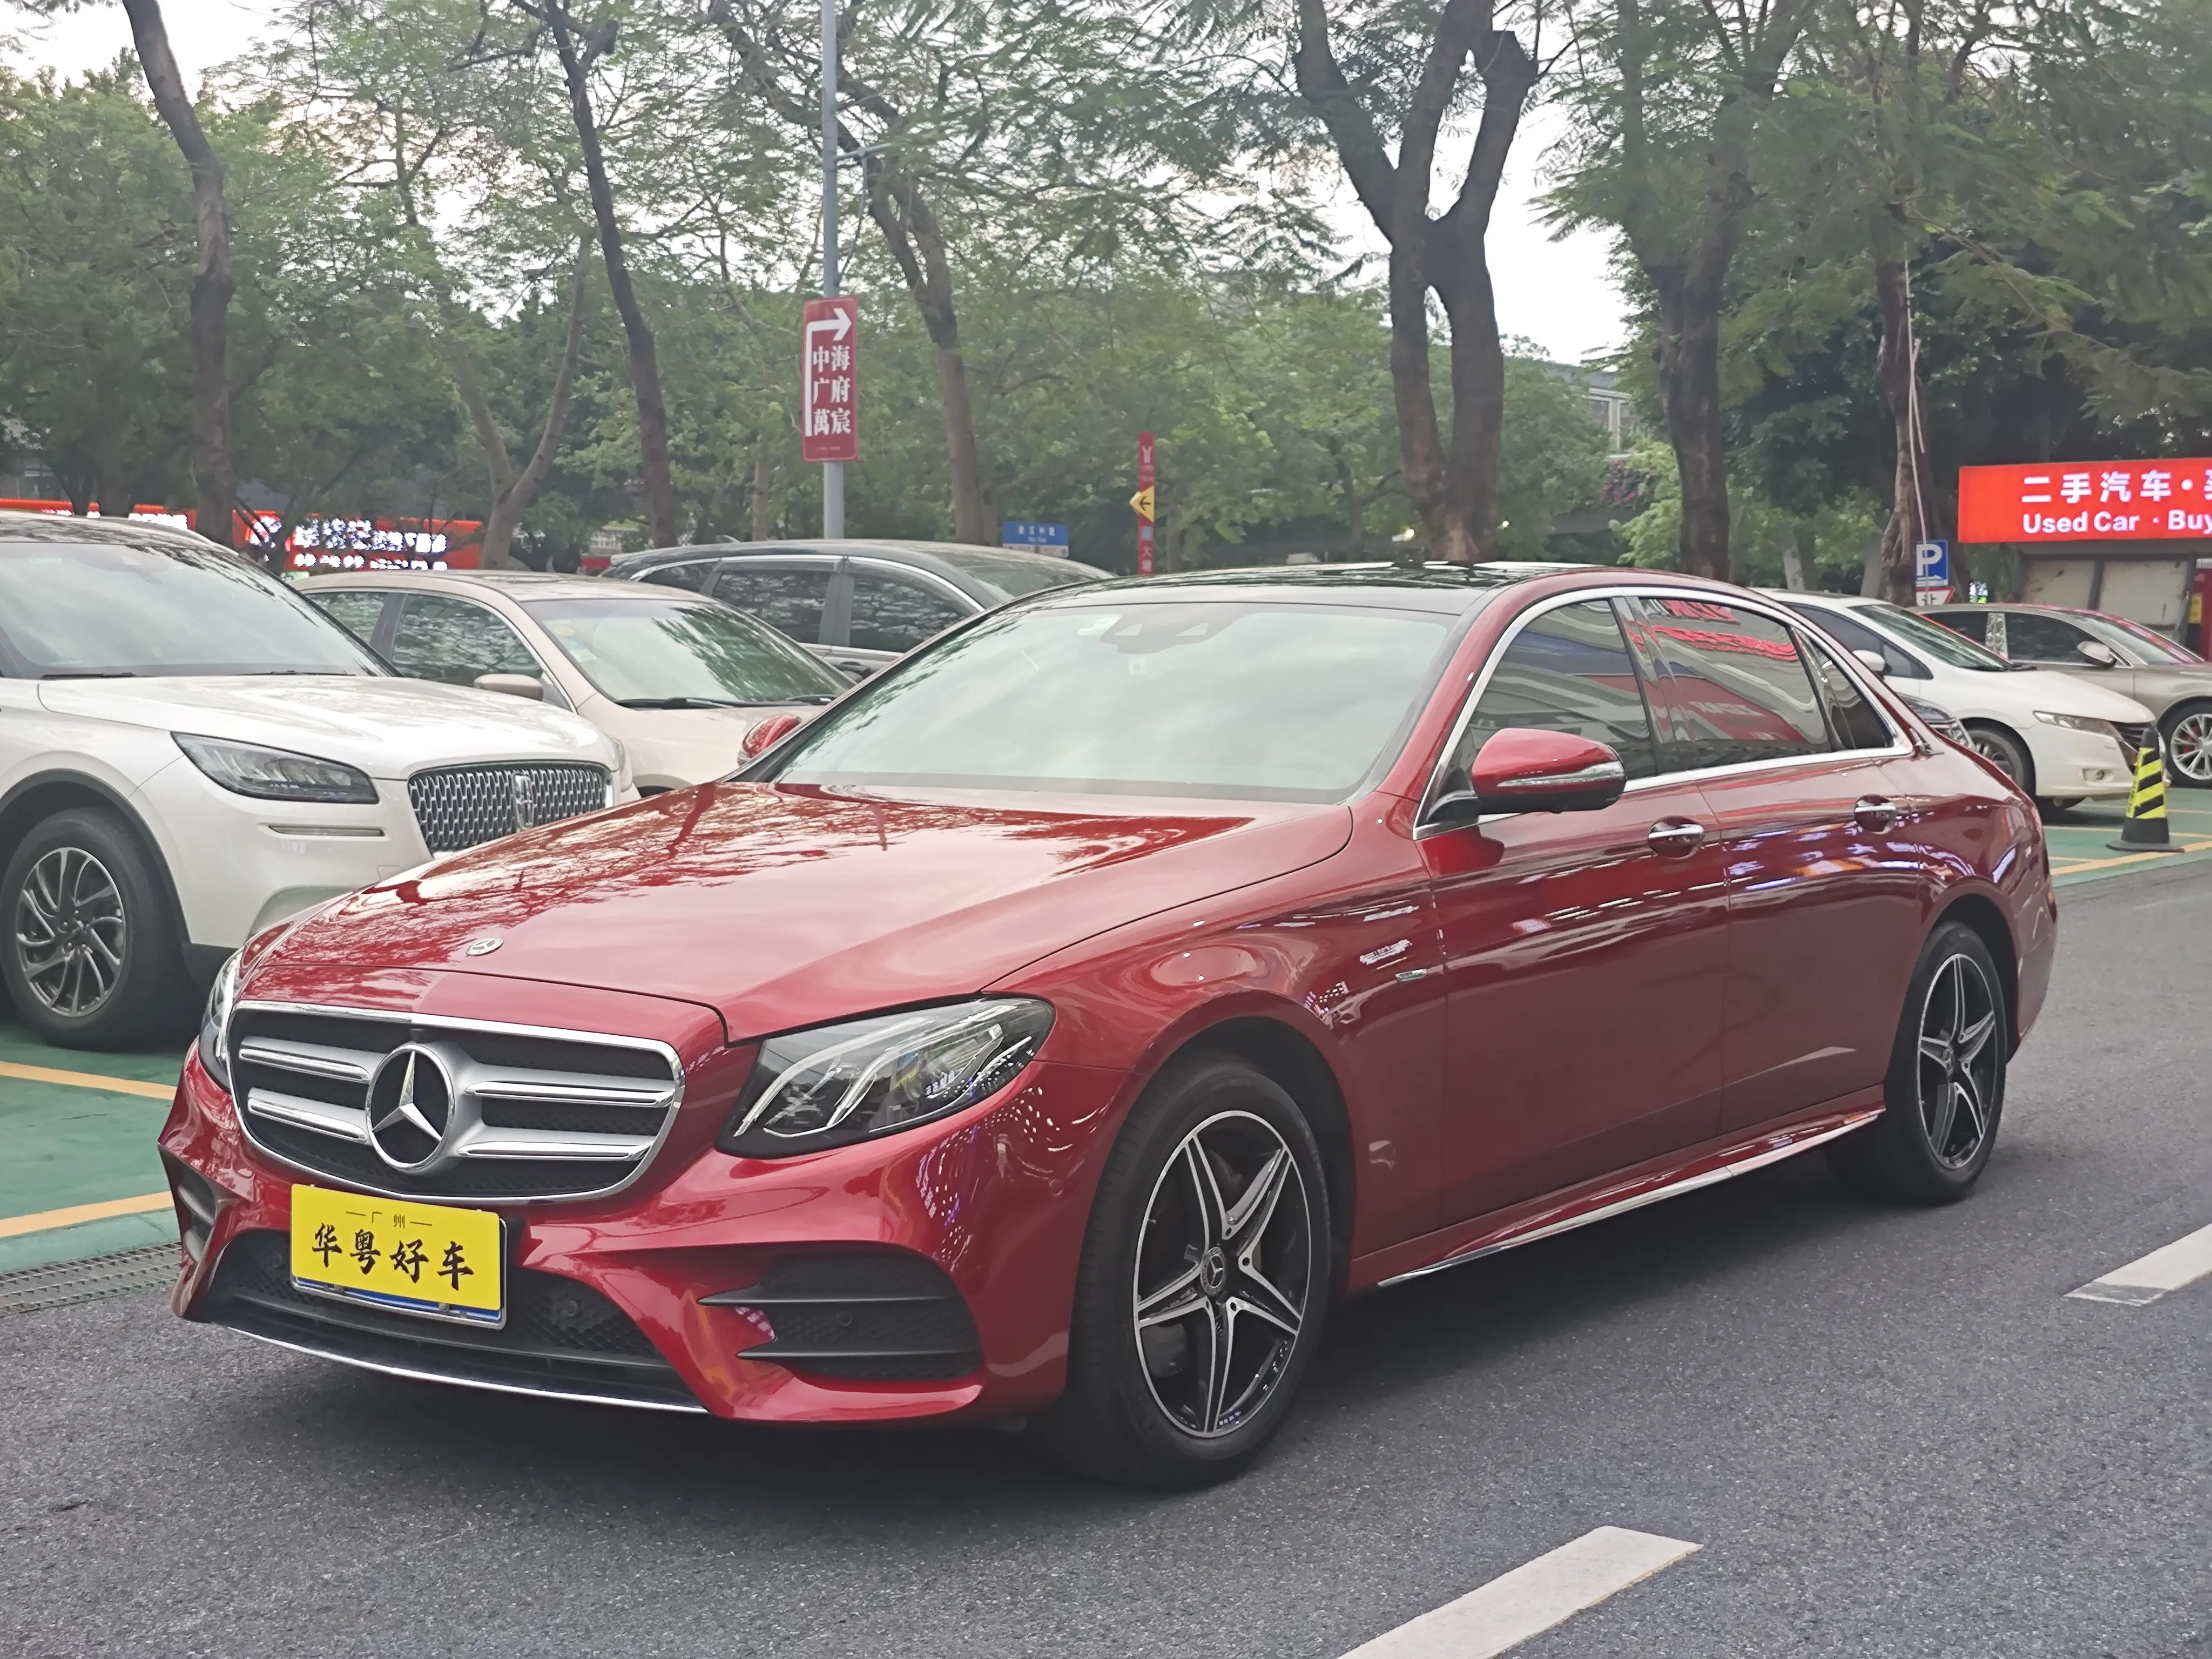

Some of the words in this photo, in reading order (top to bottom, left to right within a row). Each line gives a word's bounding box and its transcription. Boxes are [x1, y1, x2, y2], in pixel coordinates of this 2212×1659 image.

[813, 345, 850, 373] 中海
[813, 375, 851, 404] 广府
[2022, 469, 2212, 503] 二手汽车·
[2022, 511, 2087, 534] Used
[2093, 511, 2140, 532] Car
[1916, 543, 1943, 576] P
[371, 1211, 406, 1229] 广州
[312, 1222, 474, 1291] 华粤好车
